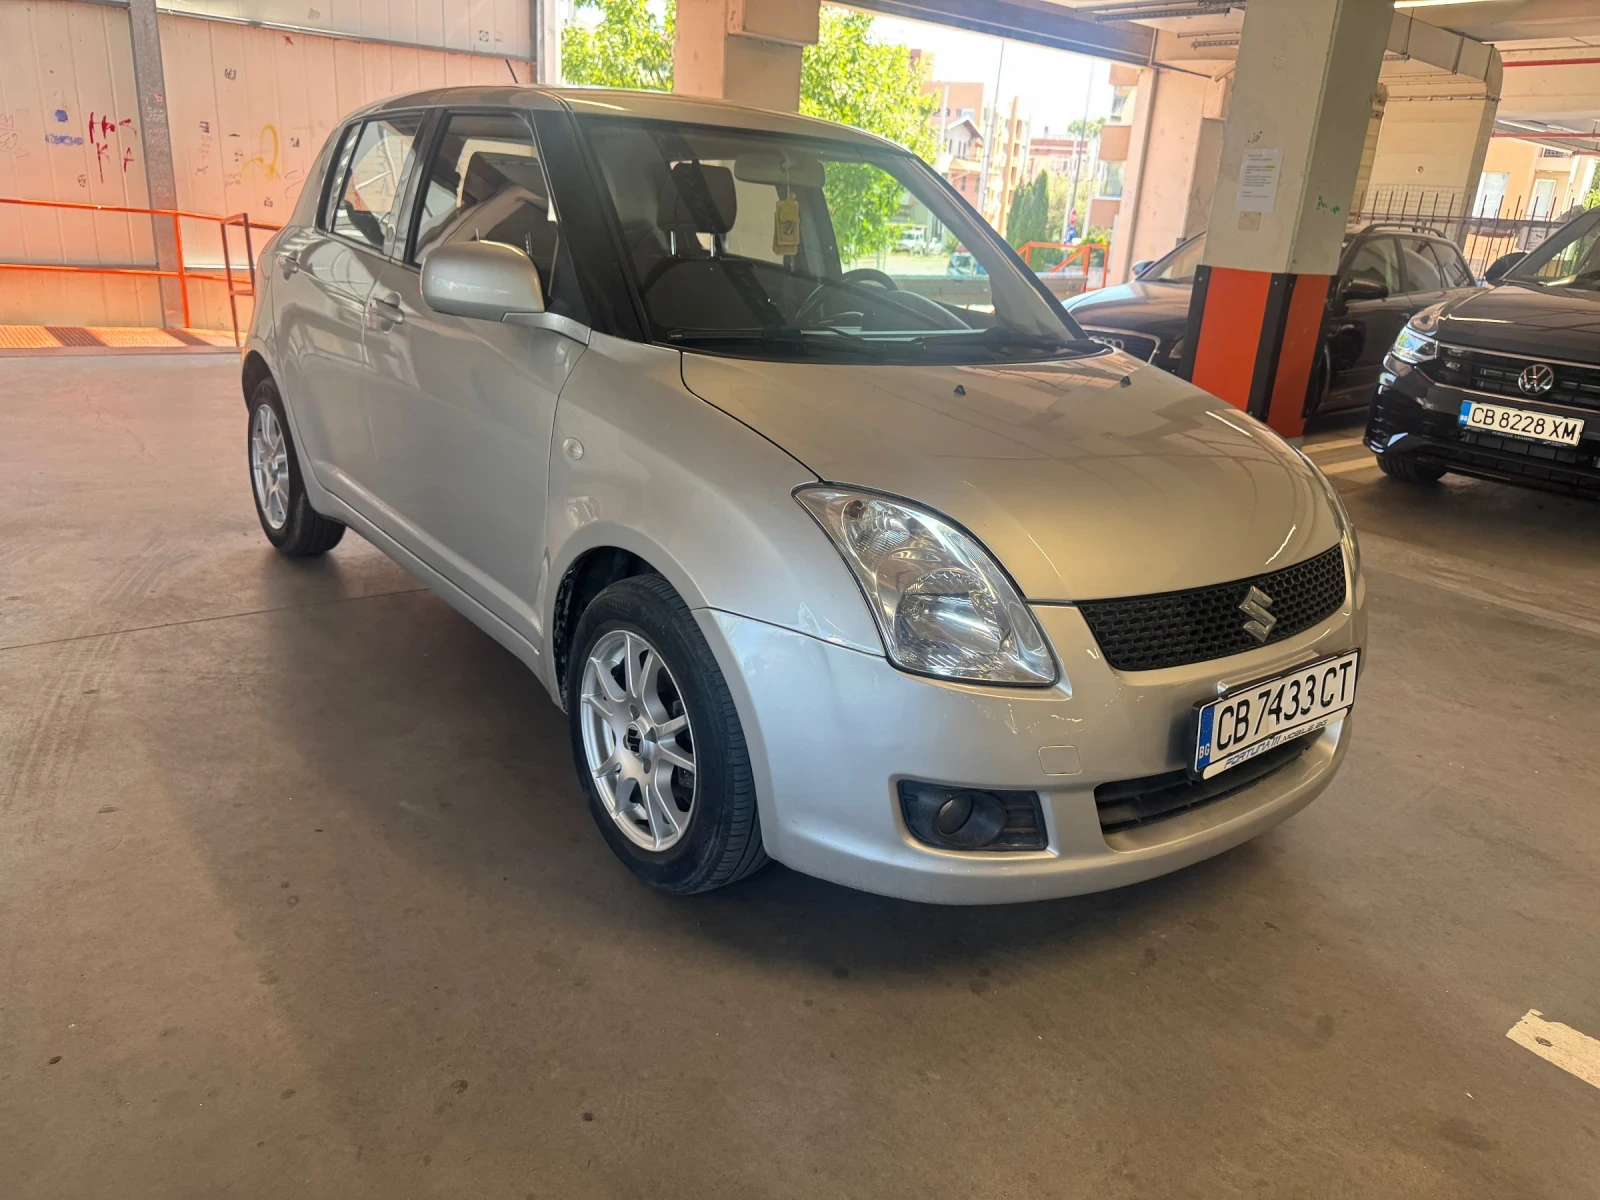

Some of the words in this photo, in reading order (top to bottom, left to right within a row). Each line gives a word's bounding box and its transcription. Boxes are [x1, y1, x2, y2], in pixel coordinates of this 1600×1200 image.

[1471, 407, 1496, 426] CB
[1499, 411, 1546, 435] 8228
[1548, 420, 1578, 441] XM
[1216, 698, 1250, 751] CB
[1253, 674, 1317, 736] 7433
[1319, 660, 1353, 708] CT
[1199, 743, 1211, 760] BG
